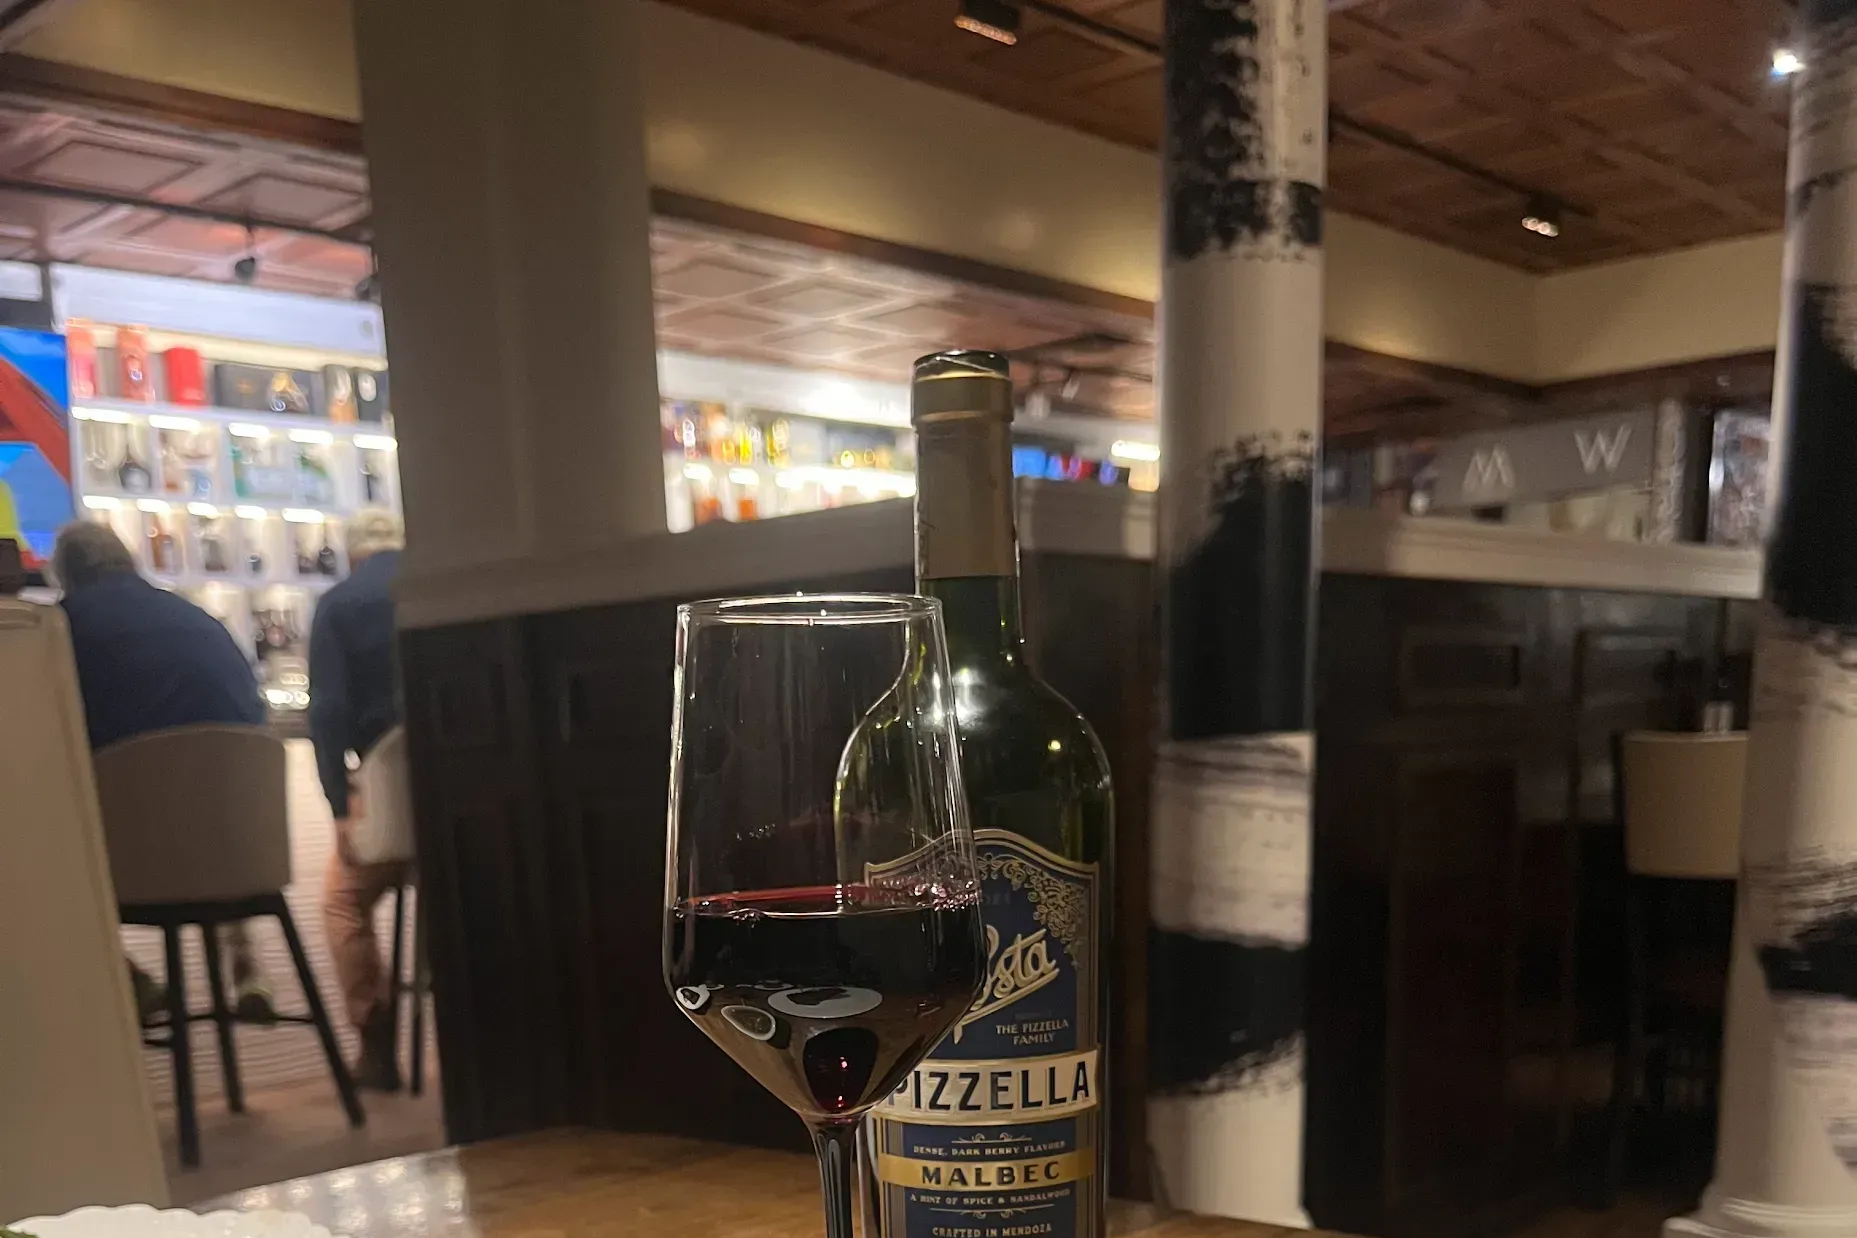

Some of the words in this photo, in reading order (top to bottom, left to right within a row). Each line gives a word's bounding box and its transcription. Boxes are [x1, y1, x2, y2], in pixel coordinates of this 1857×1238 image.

[1573, 422, 1632, 476] W
[995, 1023, 1018, 1035] THE
[1022, 1019, 1069, 1033] PIZZELLA
[1013, 1032, 1056, 1045] FAMILY
[951, 1148, 980, 1156] DARK
[984, 1146, 1019, 1156] BERRY
[922, 1160, 1060, 1187] MALBEC
[910, 1193, 917, 1202] A
[945, 1196, 959, 1205] OF
[963, 1196, 993, 1205] SPICE
[932, 1226, 981, 1238] CRAFTED
[986, 1227, 998, 1238] IN
[1002, 1223, 1053, 1238] MENDOZA
